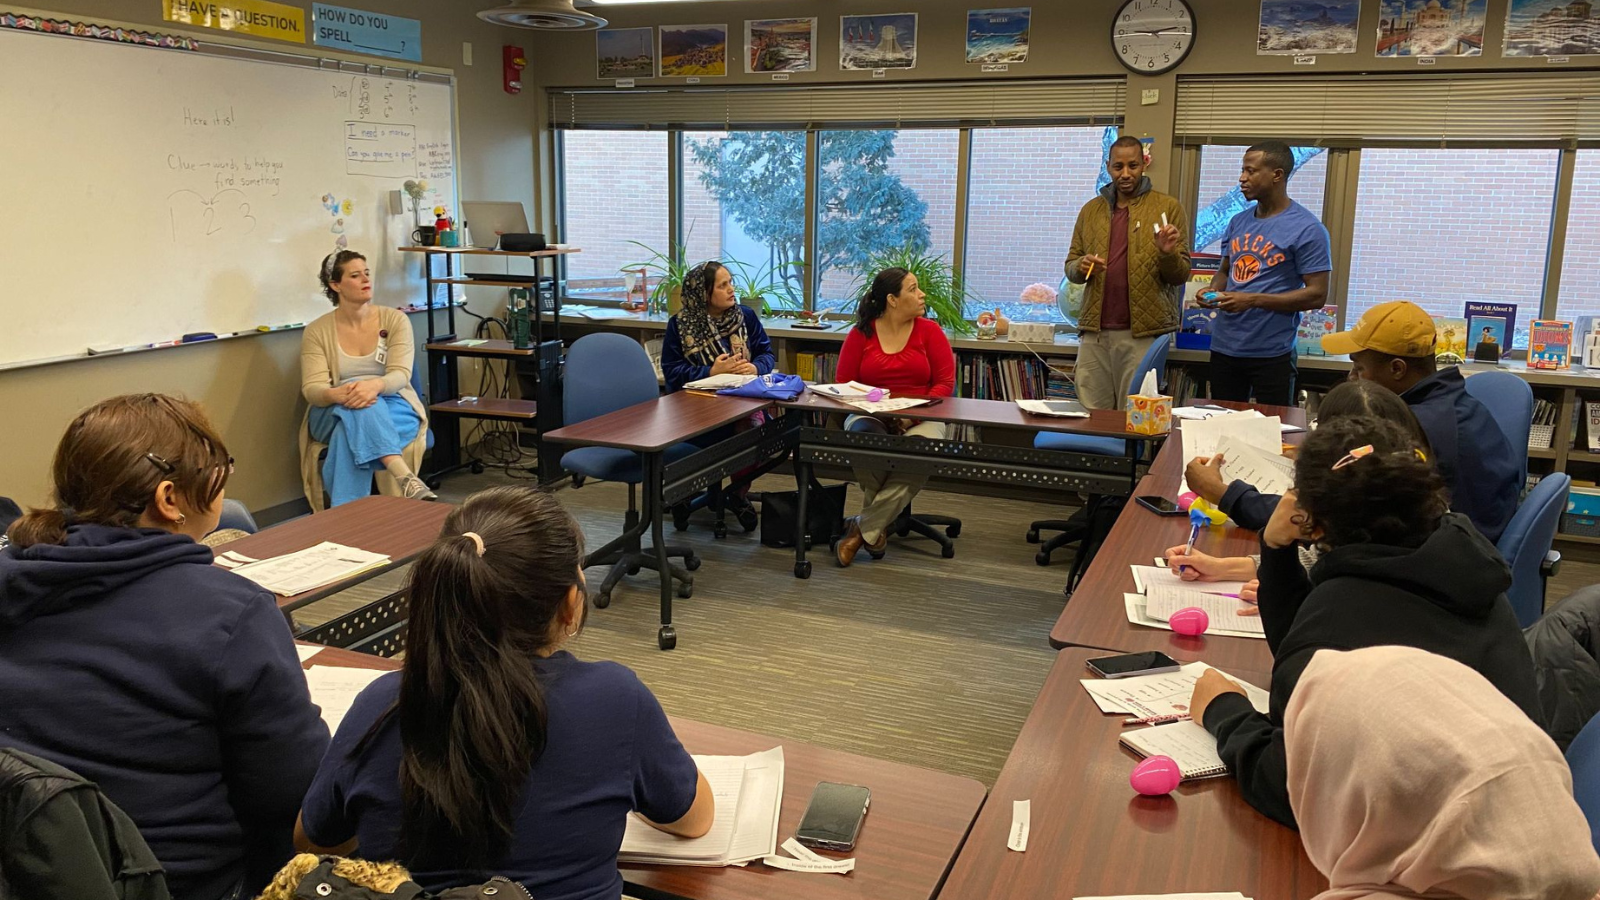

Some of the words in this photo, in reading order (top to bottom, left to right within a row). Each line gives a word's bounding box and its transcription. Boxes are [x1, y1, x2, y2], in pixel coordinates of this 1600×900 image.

[1134, 2, 1141, 10] 11
[179, 0, 217, 17] HAVE
[234, 9, 300, 32] QUESTION.
[318, 7, 346, 23] HOW
[349, 13, 365, 26] DO
[367, 16, 388, 30] YOU
[1122, 14, 1131, 22] 10
[1179, 10, 1185, 18] 2
[320, 27, 352, 42] SPELL
[1118, 29, 1125, 38] 9
[1182, 26, 1187, 35] 3
[1121, 45, 1128, 54] 8
[1175, 41, 1181, 50] 4
[1133, 56, 1139, 65] 7
[1147, 59, 1154, 68] 6
[1164, 55, 1170, 63] 5
[183, 106, 208, 126] Here
[213, 109, 220, 125] it
[346, 123, 358, 137] I
[361, 125, 378, 138] need
[347, 146, 359, 158] Can
[360, 150, 371, 160] you
[167, 153, 197, 172] Clue
[244, 156, 252, 170] to
[254, 157, 270, 173] help
[271, 162, 283, 174] you
[215, 171, 235, 190] find
[240, 173, 280, 196] something
[203, 206, 222, 235] 2
[239, 202, 257, 236] 3
